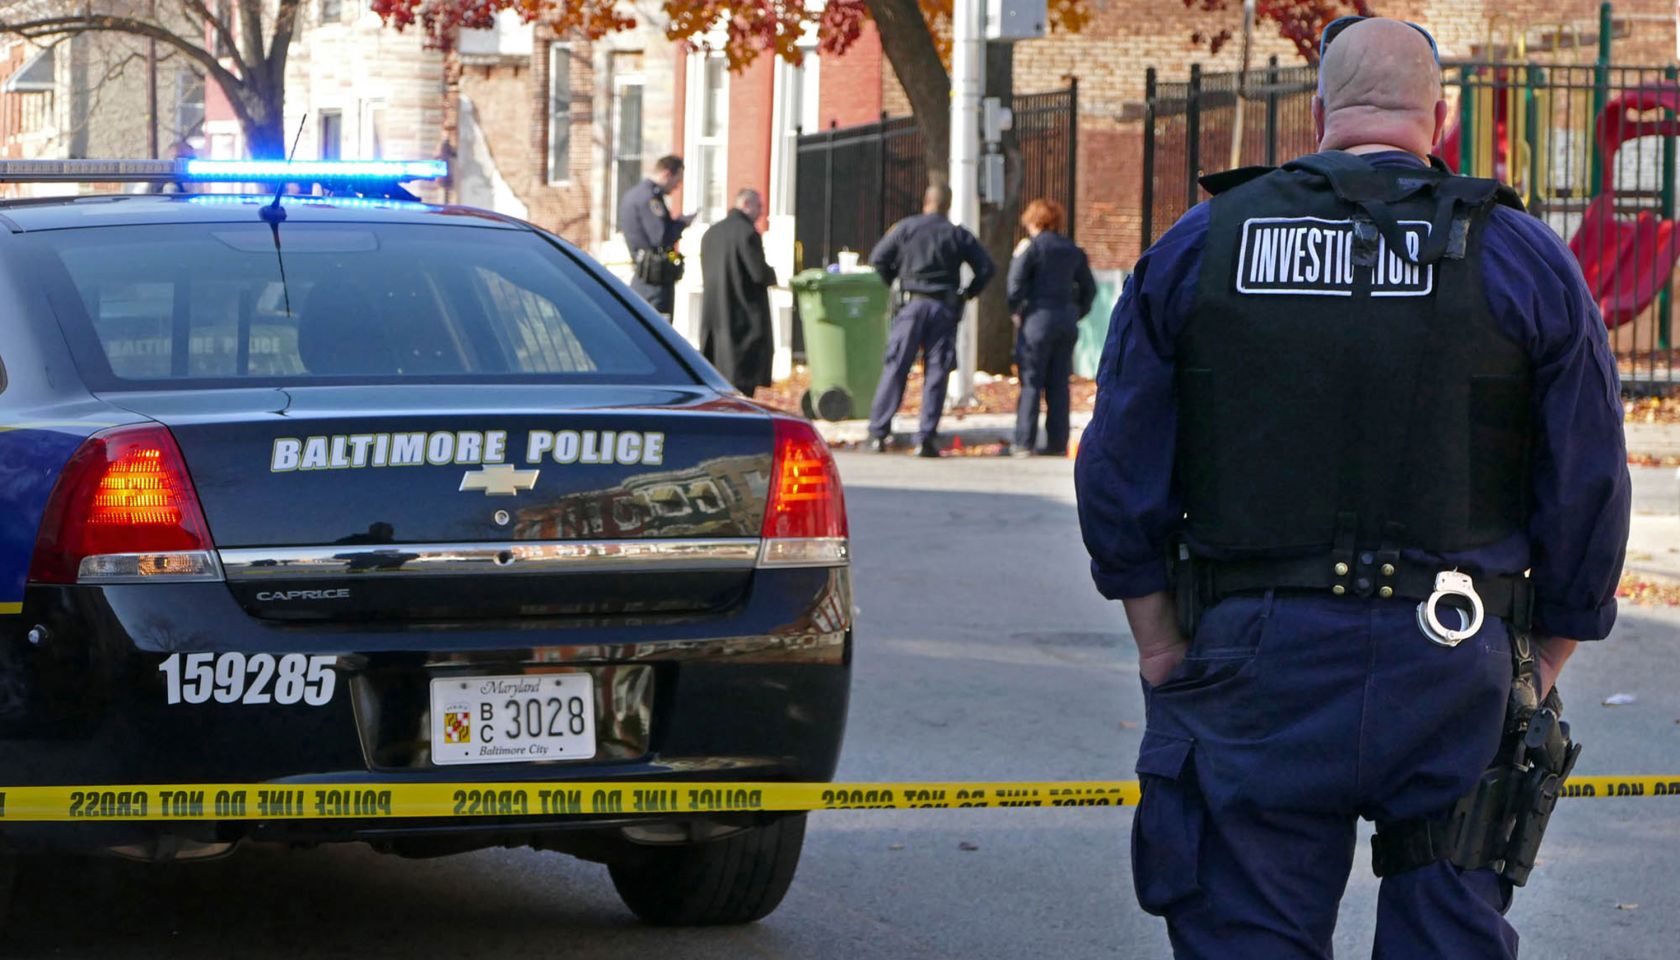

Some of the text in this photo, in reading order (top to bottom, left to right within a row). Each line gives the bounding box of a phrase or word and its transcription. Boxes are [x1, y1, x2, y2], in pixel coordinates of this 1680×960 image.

[1250, 228, 1419, 285] INVESTITOR
[271, 430, 665, 472] BALTIMORE POLICE
[256, 588, 350, 601] CAPRICE
[158, 652, 337, 706] 159285
[480, 678, 541, 698] Maryland
[505, 696, 585, 739] 3028
[479, 744, 549, 756] Baltimore City
